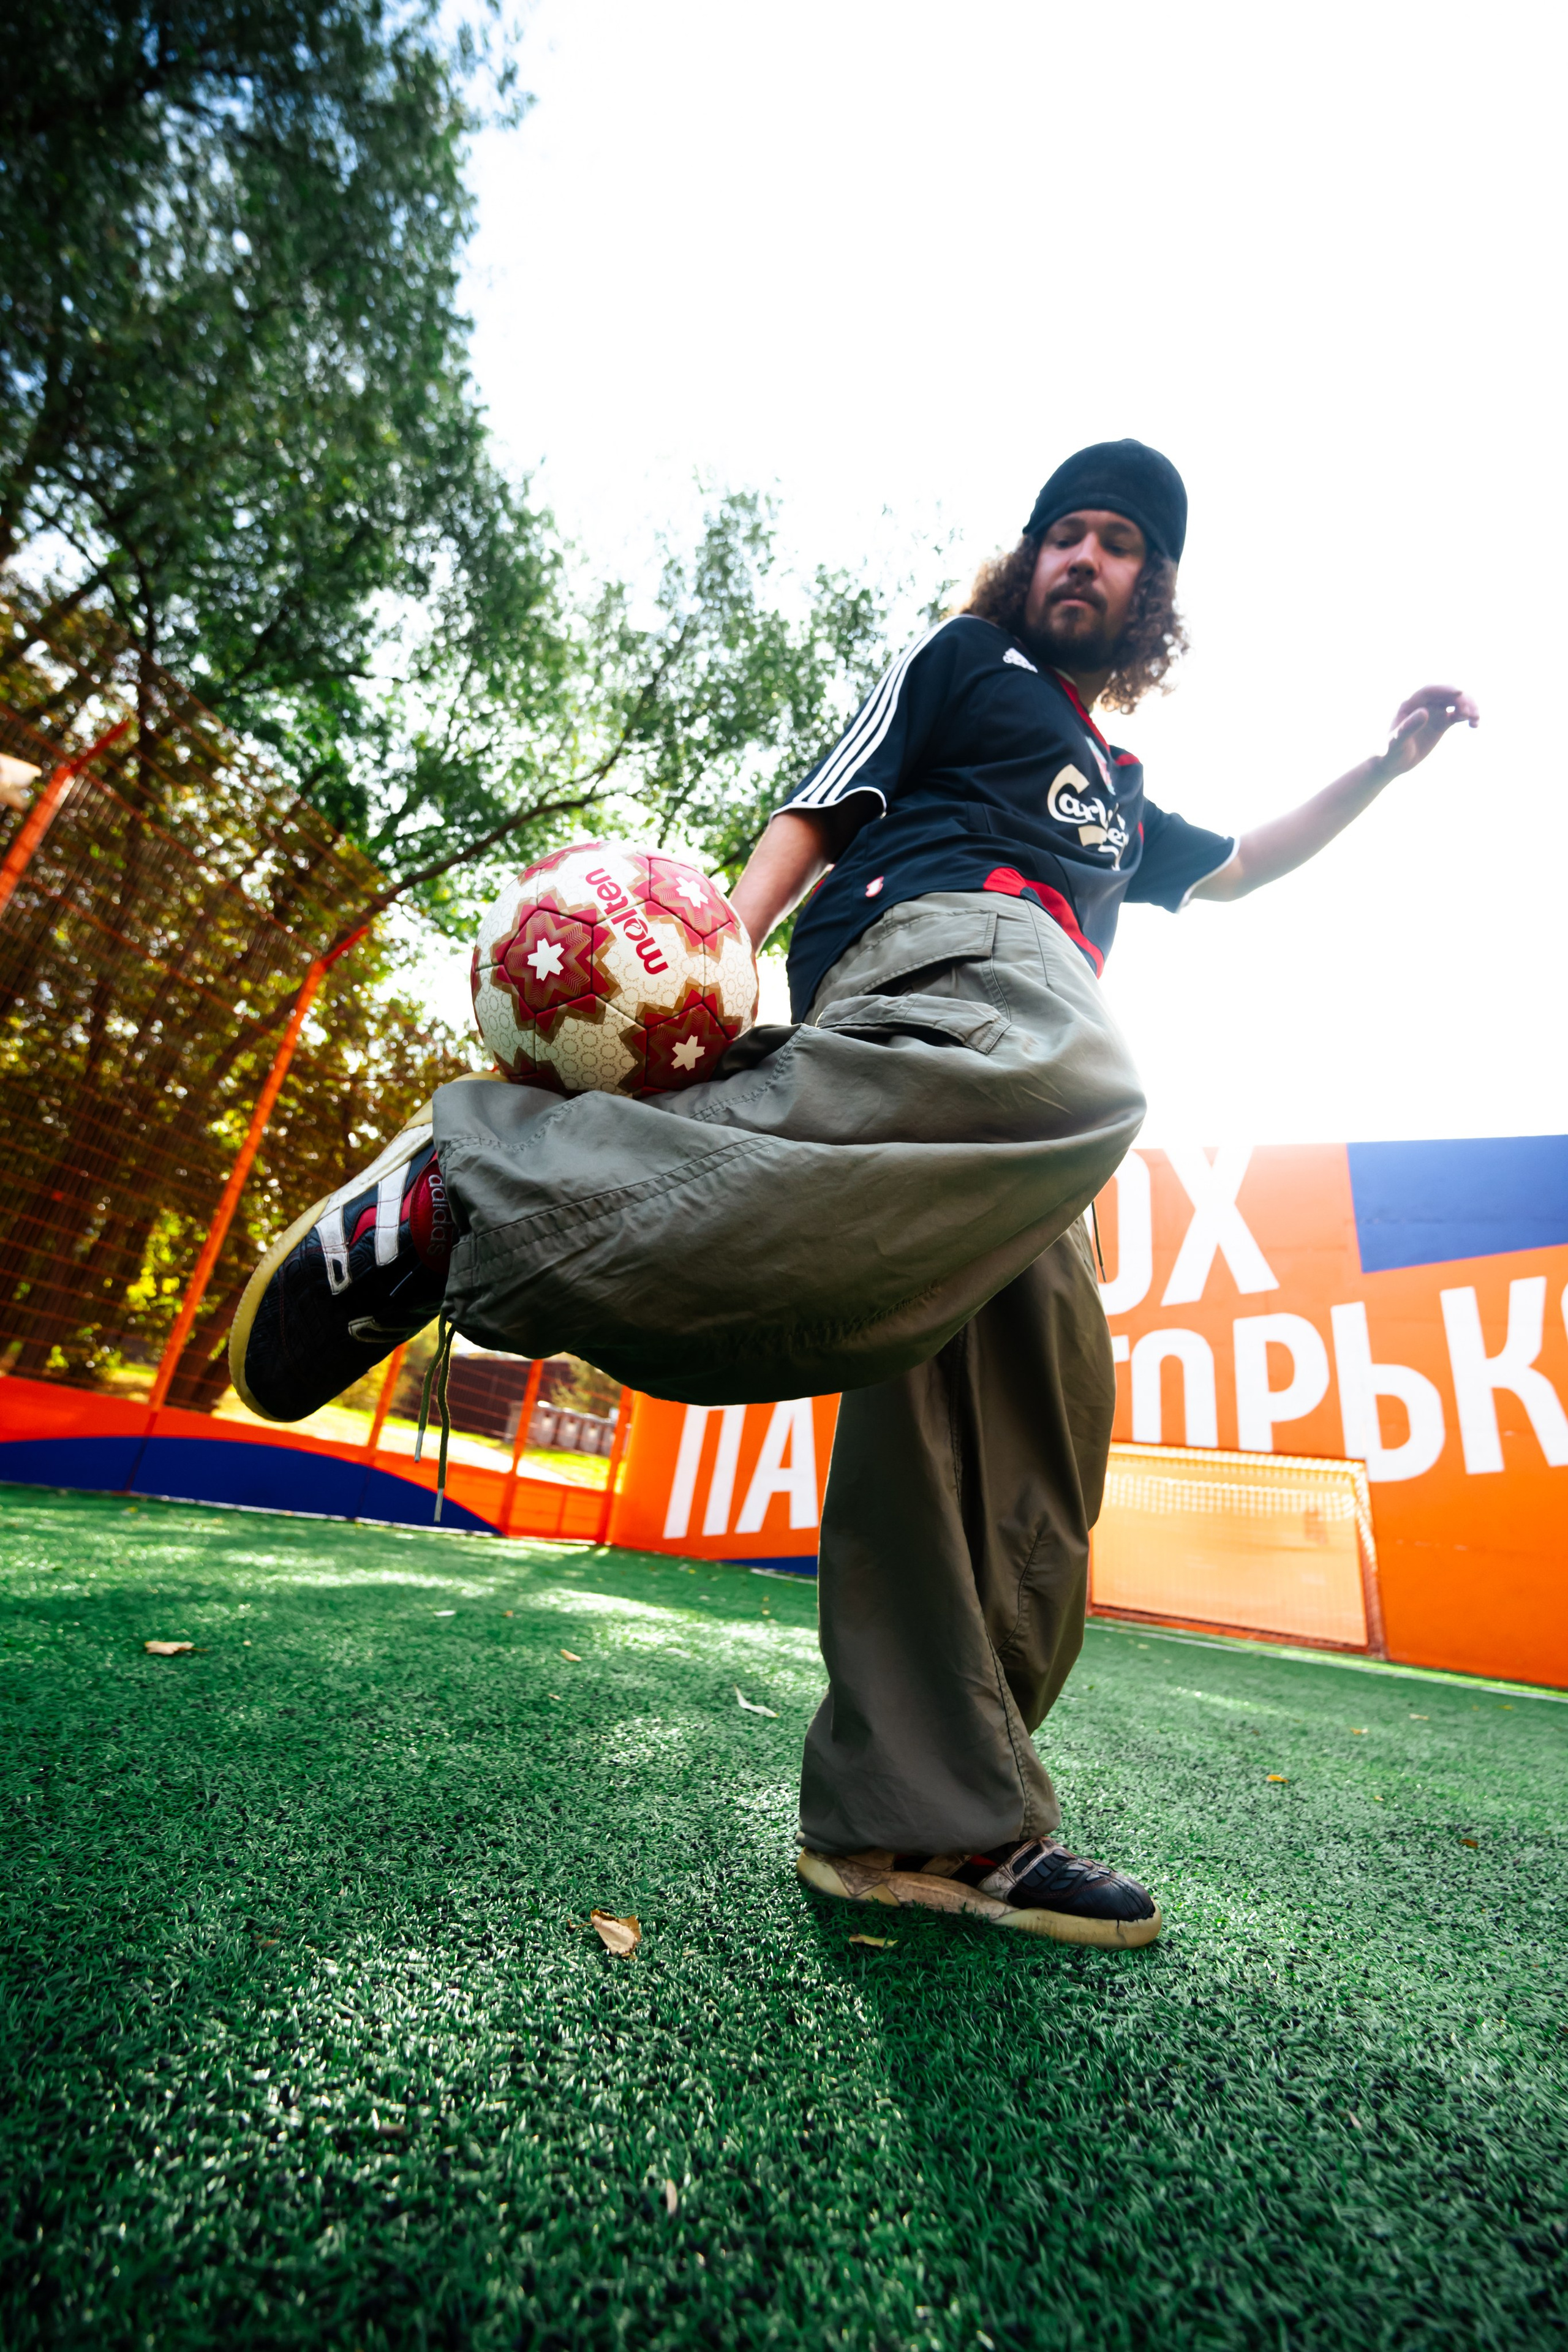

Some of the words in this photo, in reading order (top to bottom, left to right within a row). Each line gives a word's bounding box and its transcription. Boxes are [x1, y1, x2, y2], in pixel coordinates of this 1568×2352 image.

[586, 867, 669, 974] molten
[427, 1174, 454, 1255] adidas
[663, 1397, 819, 1539] ПА
